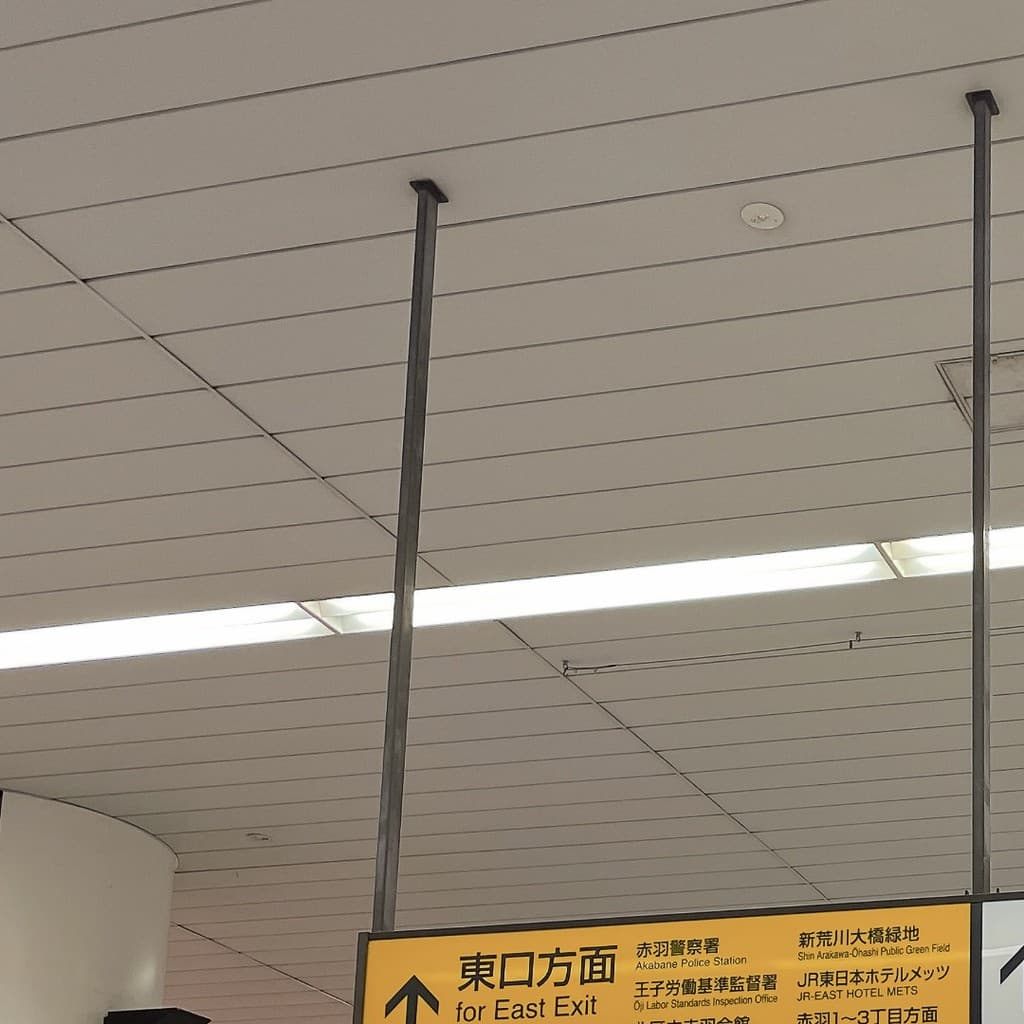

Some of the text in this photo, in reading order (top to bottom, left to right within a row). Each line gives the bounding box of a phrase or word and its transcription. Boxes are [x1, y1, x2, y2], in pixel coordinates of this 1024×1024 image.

[798, 925, 920, 948] 新荒川大橋緑地
[636, 938, 720, 958] 赤羽警察署
[798, 951, 815, 961] Shin
[881, 946, 904, 956] Public
[906, 944, 930, 954] Green
[932, 943, 951, 953] Field
[458, 945, 618, 991] 東口方面
[636, 956, 747, 970] Akabane Police Station
[634, 974, 778, 998] 王子労働基準監督署
[797, 965, 950, 988] JR東日本ホテルメッツ
[646, 999, 669, 1010] Labor
[671, 997, 711, 1009] Standards
[713, 995, 753, 1007] Inspection
[755, 993, 778, 1004] Office
[796, 985, 918, 1001] JR-EAST HOTEL METS
[456, 995, 597, 1023] for East Exit
